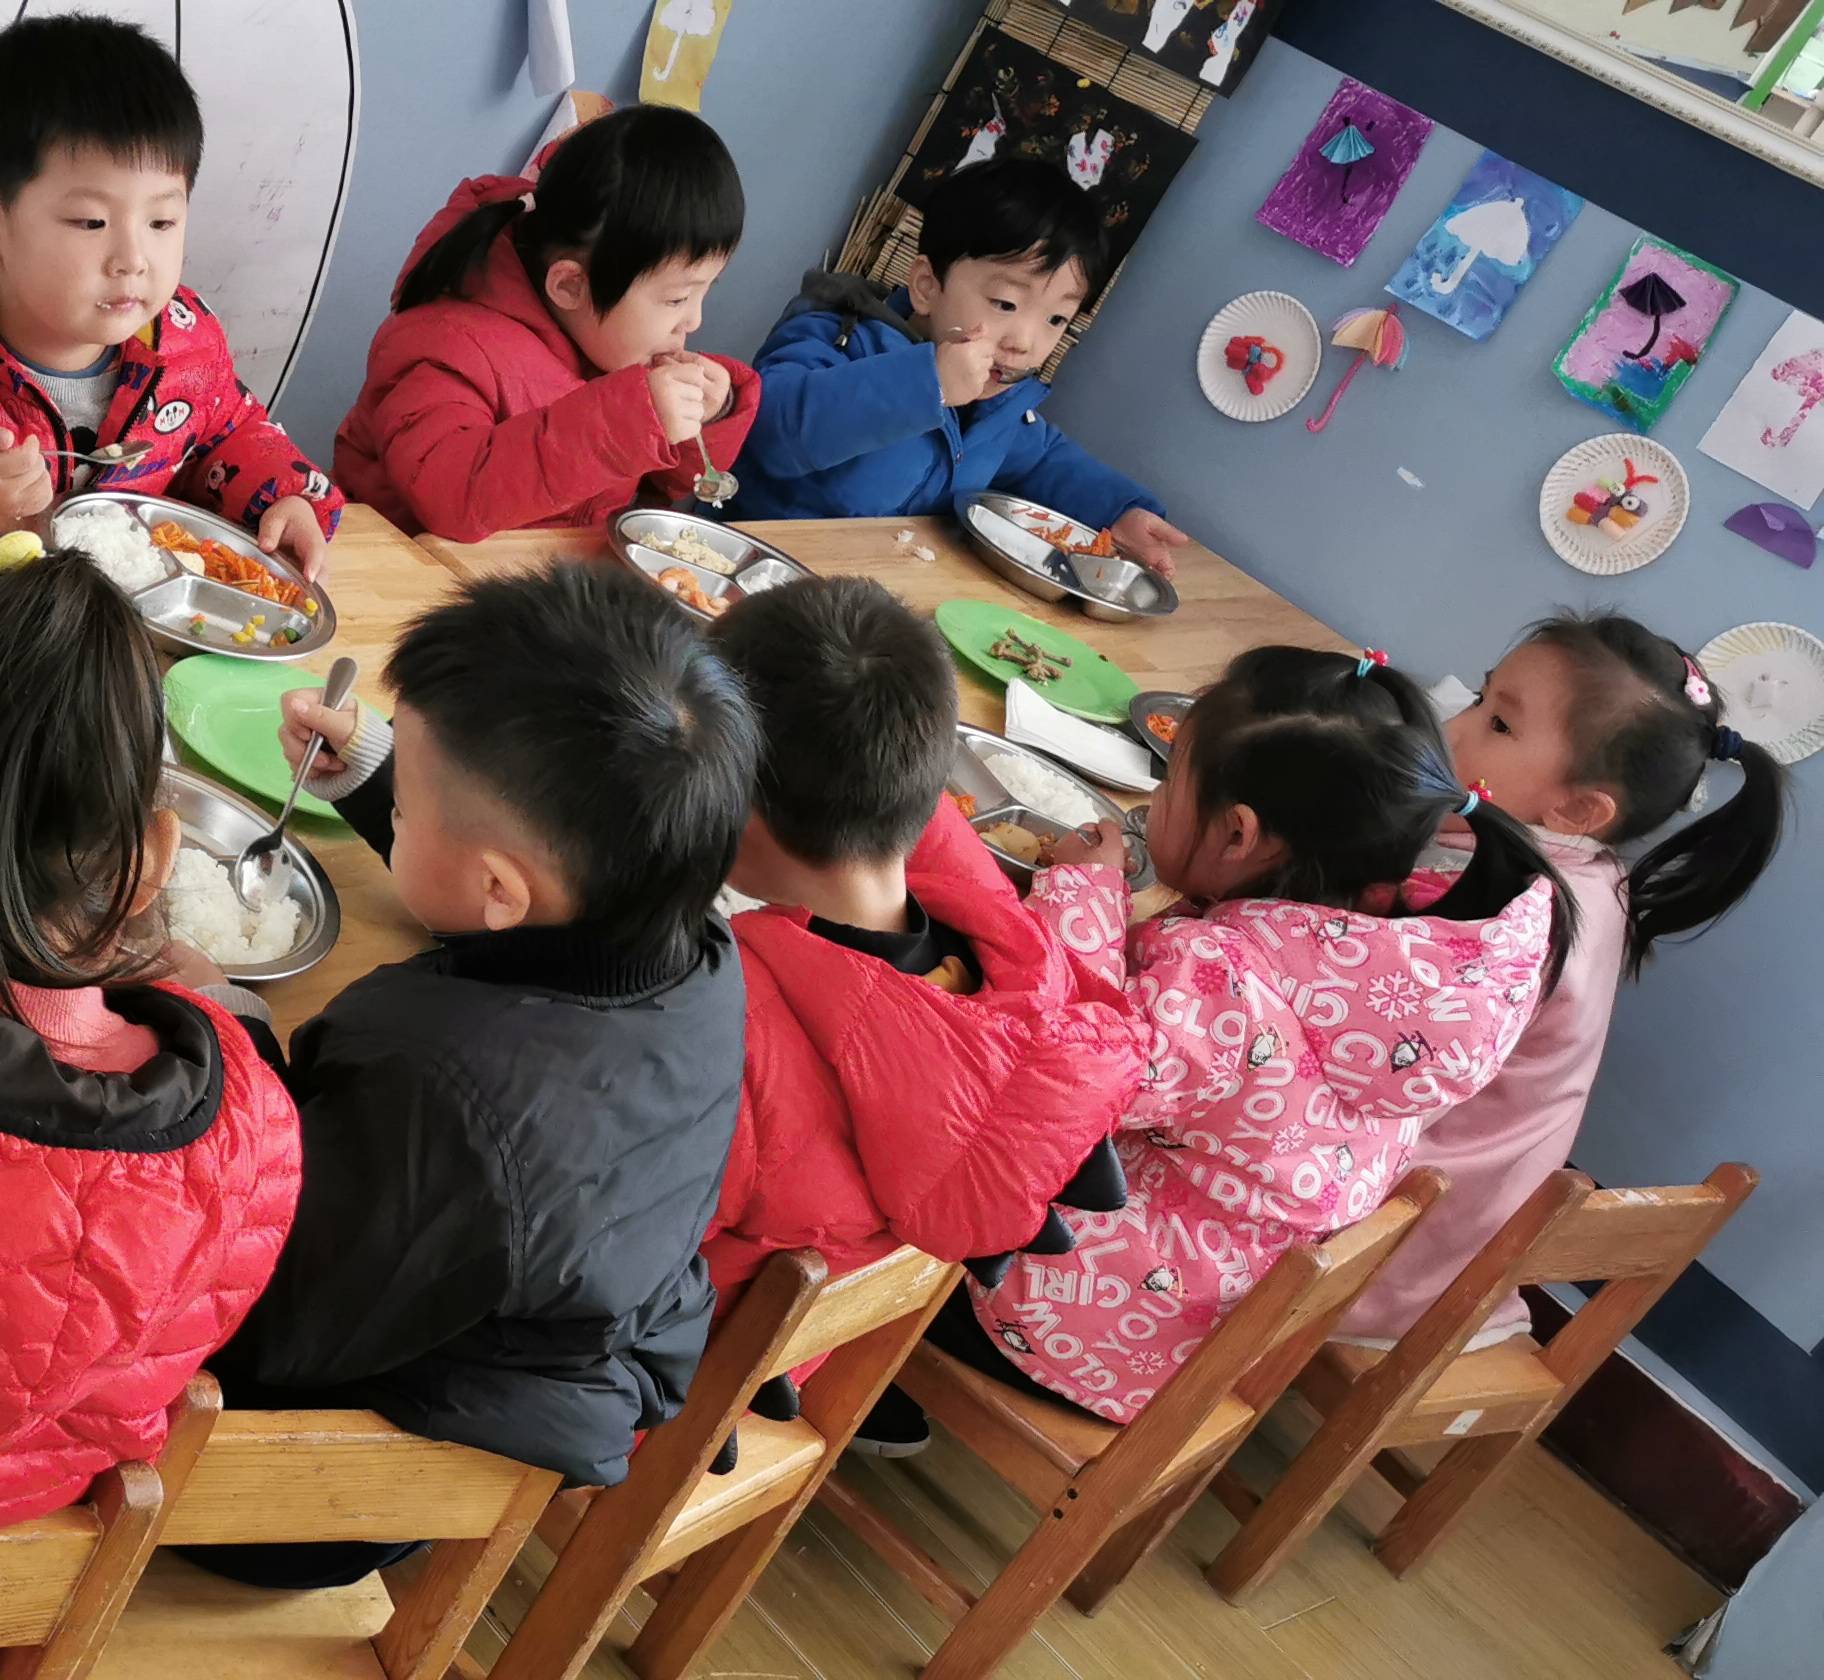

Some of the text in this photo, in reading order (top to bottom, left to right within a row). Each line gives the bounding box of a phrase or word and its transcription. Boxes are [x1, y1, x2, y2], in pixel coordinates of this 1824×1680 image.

[1229, 1055, 1298, 1141] YOU
[1022, 1262, 1132, 1309] GIRL
[1010, 1300, 1119, 1393] GLOW
[1090, 1291, 1184, 1356] YOU
